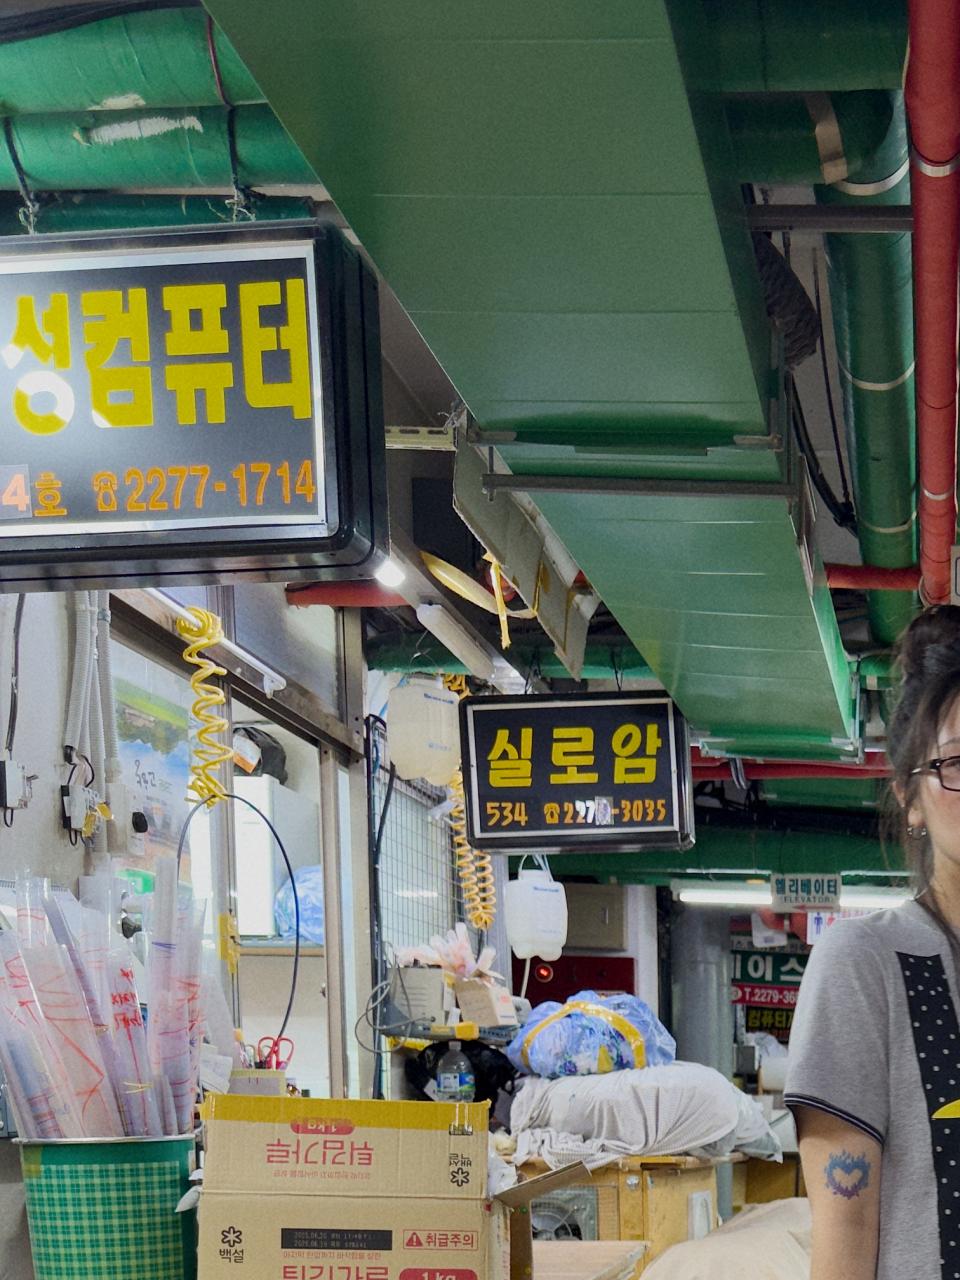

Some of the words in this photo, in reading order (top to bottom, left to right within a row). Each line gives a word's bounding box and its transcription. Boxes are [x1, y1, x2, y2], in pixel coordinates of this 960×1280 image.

[2, 278, 312, 435] 성컴퓨터
[126, 459, 316, 512] 2277-1714
[487, 722, 663, 788] 실로암
[486, 801, 528, 827] 534
[775, 878, 838, 897] 엘리베이터
[265, 1138, 374, 1167] 튀김가루
[425, 1232, 475, 1248] 취급주의
[219, 1248, 245, 1264] 백설
